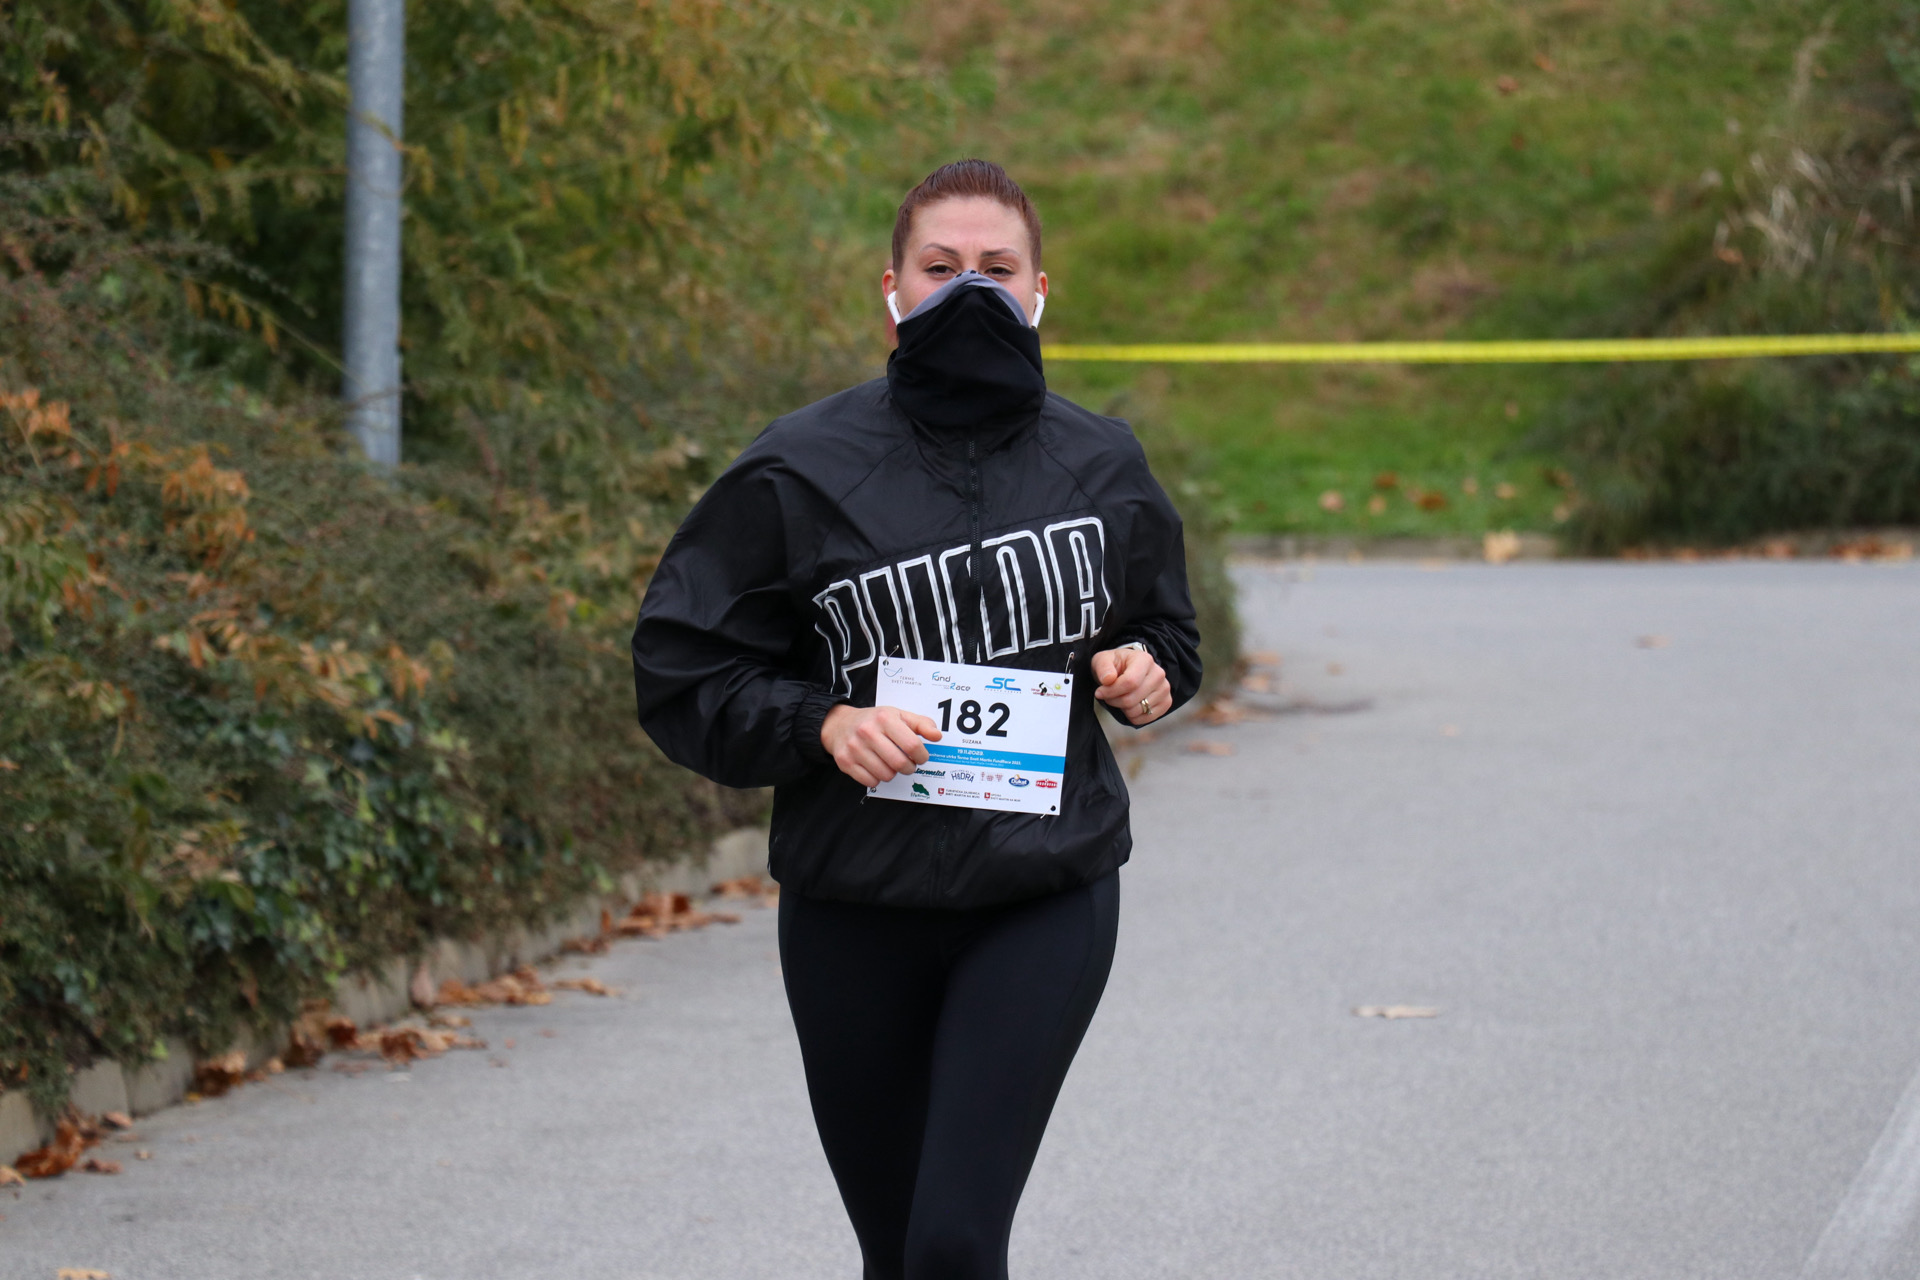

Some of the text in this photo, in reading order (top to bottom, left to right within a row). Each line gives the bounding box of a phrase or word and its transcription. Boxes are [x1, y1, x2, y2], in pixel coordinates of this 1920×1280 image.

[812, 517, 1111, 698] PUMA
[985, 677, 1022, 691] SC
[937, 698, 1011, 738] 182
